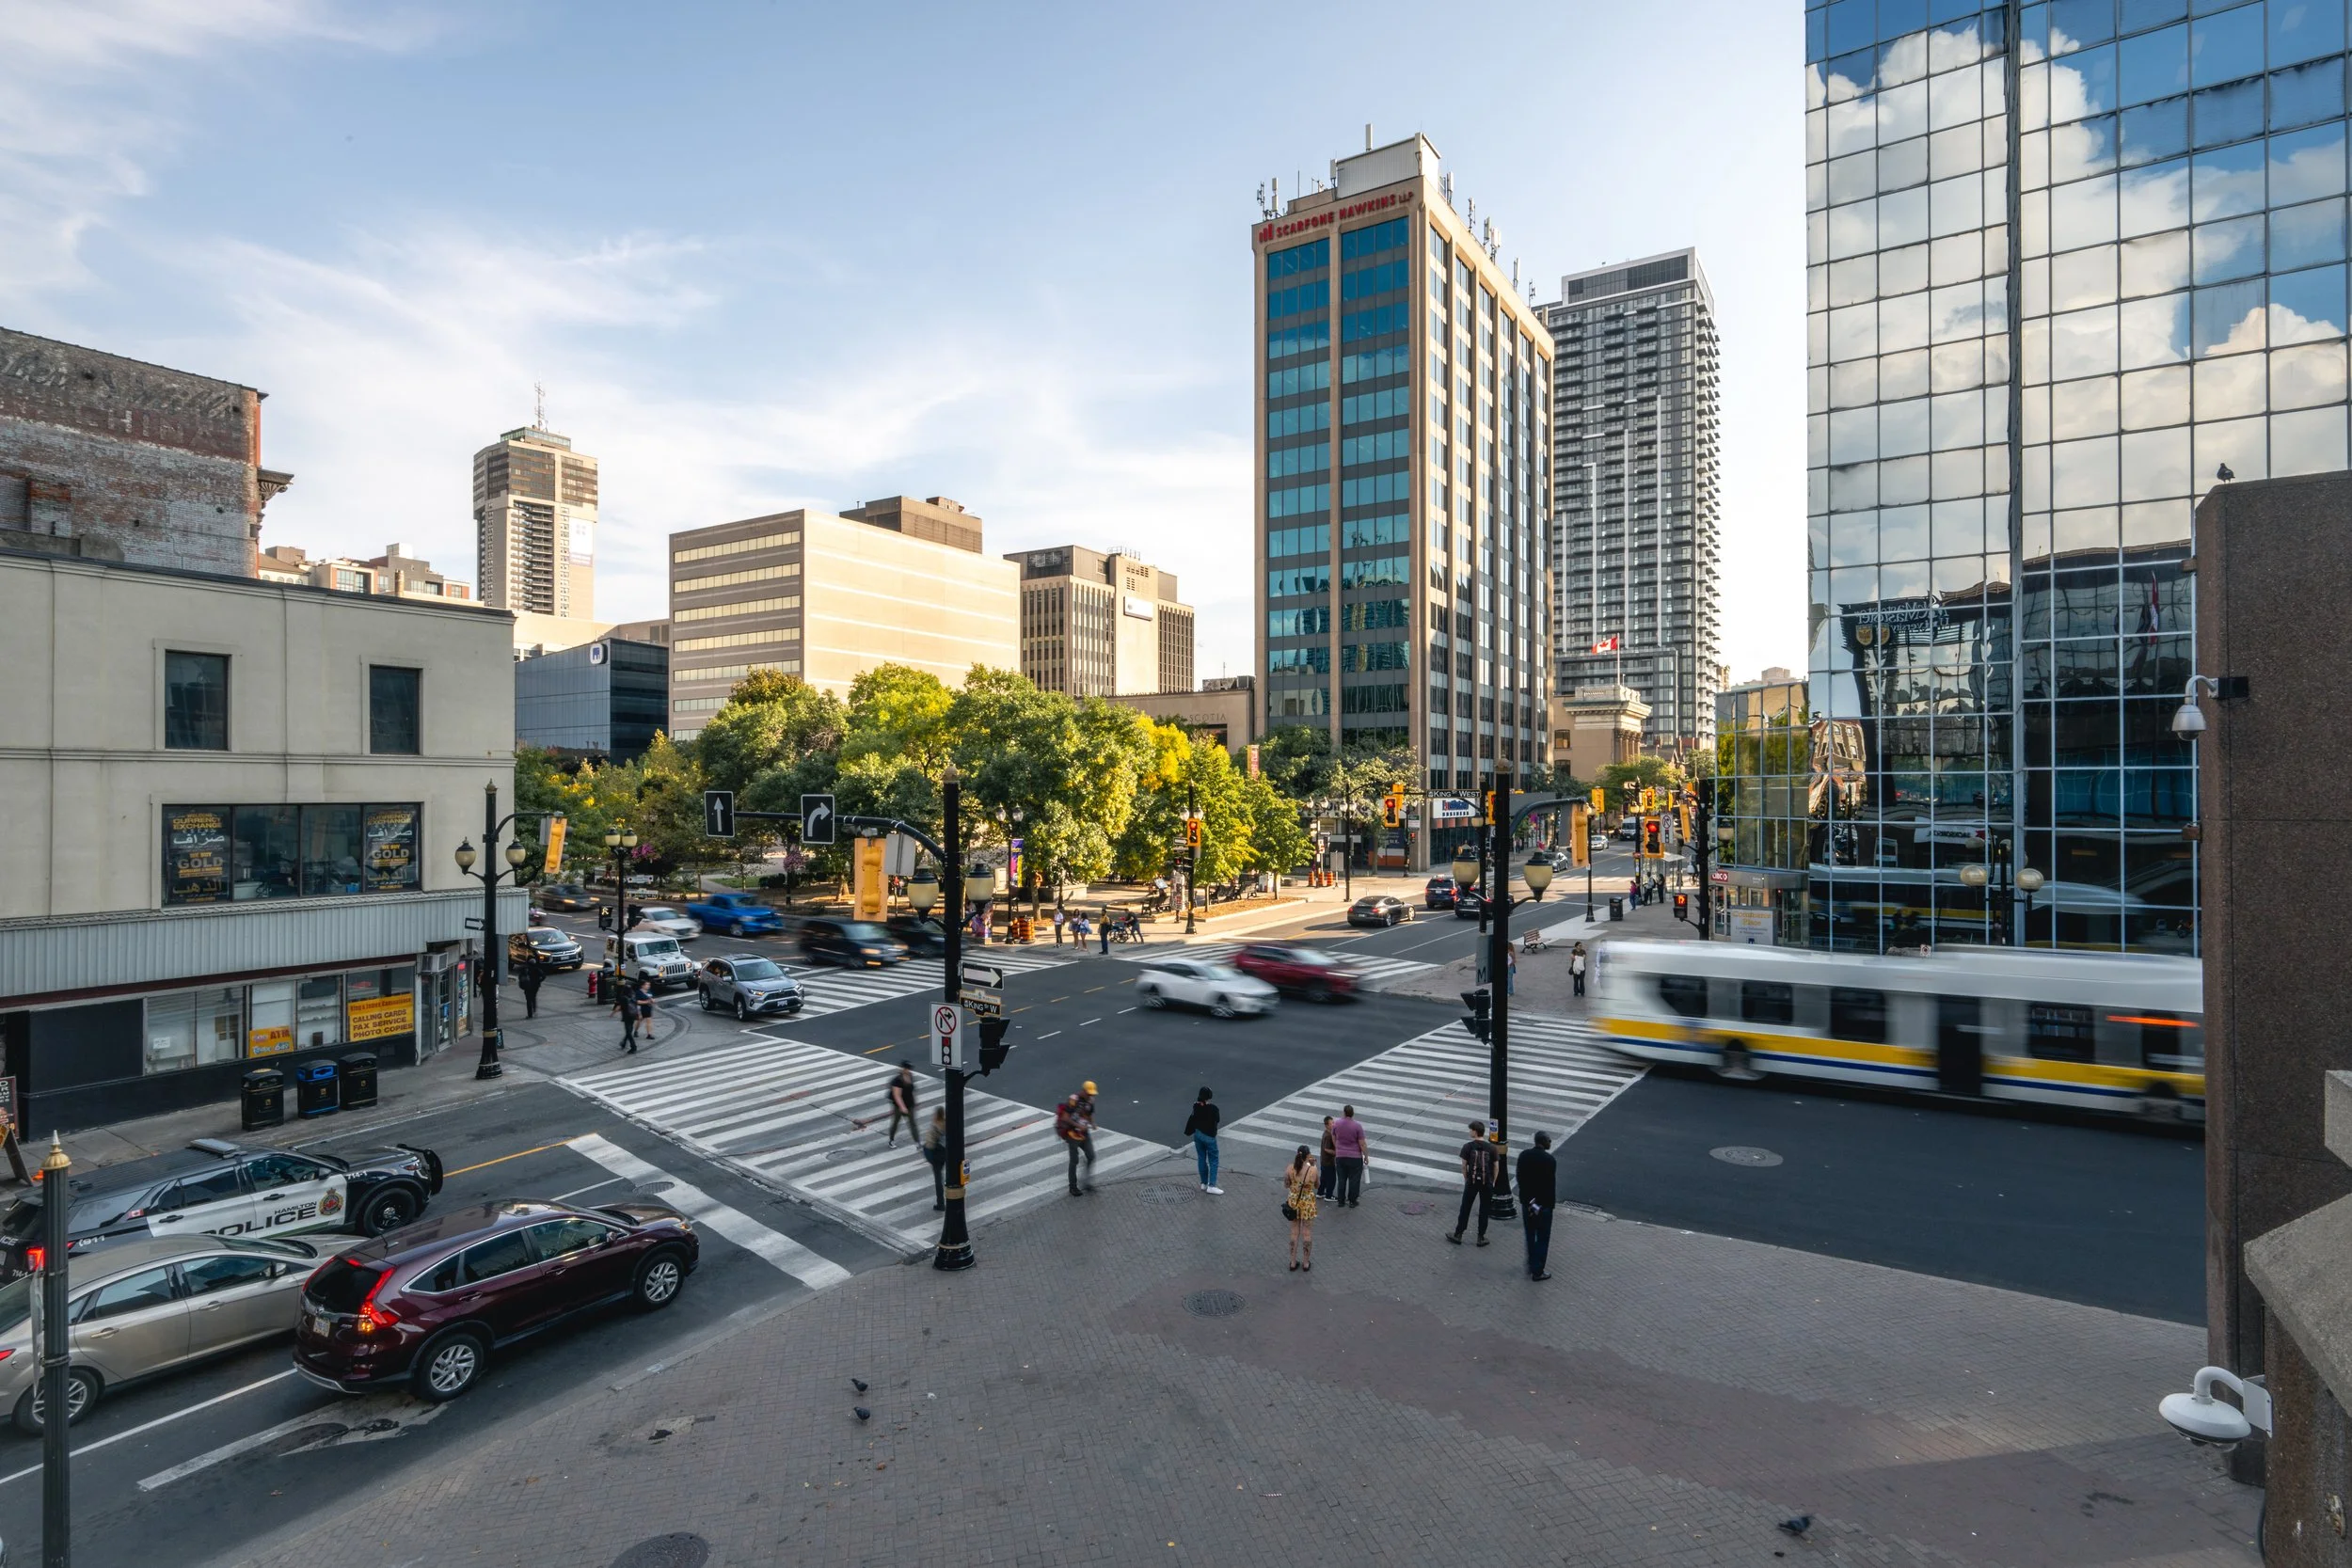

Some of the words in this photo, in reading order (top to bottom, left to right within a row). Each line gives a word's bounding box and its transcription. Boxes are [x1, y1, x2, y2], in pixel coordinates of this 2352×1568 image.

[1276, 211, 1334, 238] SCARFONE
[1339, 193, 1396, 220] HAWKINS
[1398, 191, 1415, 204] LLP
[1188, 713, 1227, 722] SCOTIA
[172, 816, 222, 825] CURRENCY
[172, 822, 223, 831] EXCHANGE
[372, 848, 410, 860] GOLD
[177, 856, 224, 869] GOLD
[1477, 966, 1486, 983] M
[969, 1000, 984, 1011] KING
[990, 1005, 997, 1014] W
[353, 1013, 383, 1023] CALLING
[384, 1009, 407, 1019] CARDS
[353, 1023, 370, 1032] FAX
[372, 1017, 407, 1028] SERVICE
[353, 1028, 382, 1038] PHOTO
[383, 1022, 413, 1034] COPIES
[270, 1029, 290, 1040] ATM
[347, 1170, 369, 1180] 714-1
[274, 1200, 318, 1215] HAMILTON
[199, 1206, 316, 1236] OLICE
